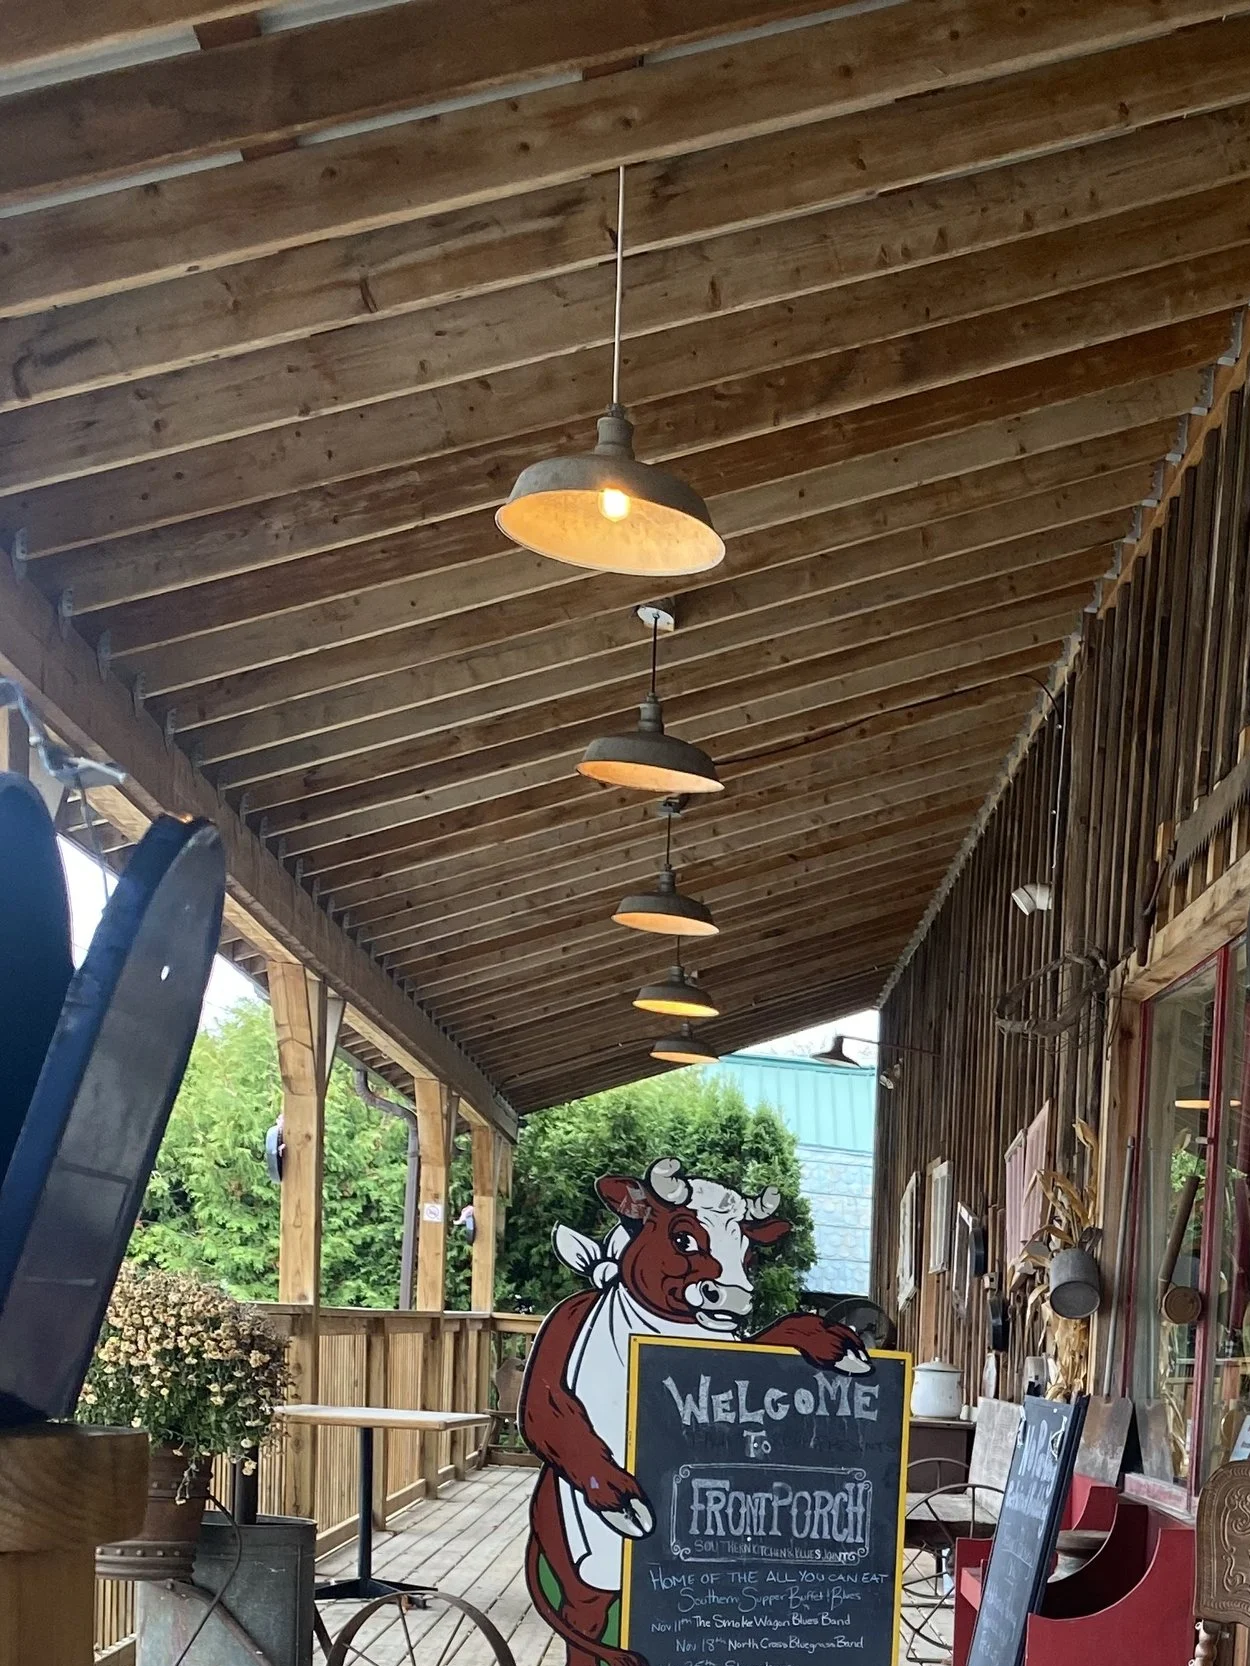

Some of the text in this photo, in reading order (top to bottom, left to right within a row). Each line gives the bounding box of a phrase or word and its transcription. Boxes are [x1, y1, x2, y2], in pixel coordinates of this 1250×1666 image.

[649, 1567, 889, 1591] HOME OF THE ALL YOU CAN EAT
[678, 1586, 740, 1612] Southern
[738, 1586, 786, 1612] Supper
[651, 1622, 673, 1633] Nov
[694, 1615, 711, 1628] The
[712, 1614, 754, 1628] Smoke
[754, 1616, 791, 1630] Wagon
[792, 1612, 820, 1626] Blues
[821, 1612, 851, 1626] Band
[675, 1639, 697, 1652] Nov
[728, 1637, 759, 1651] North
[789, 1635, 836, 1653] Bluegrass
[834, 1635, 864, 1649] Band
